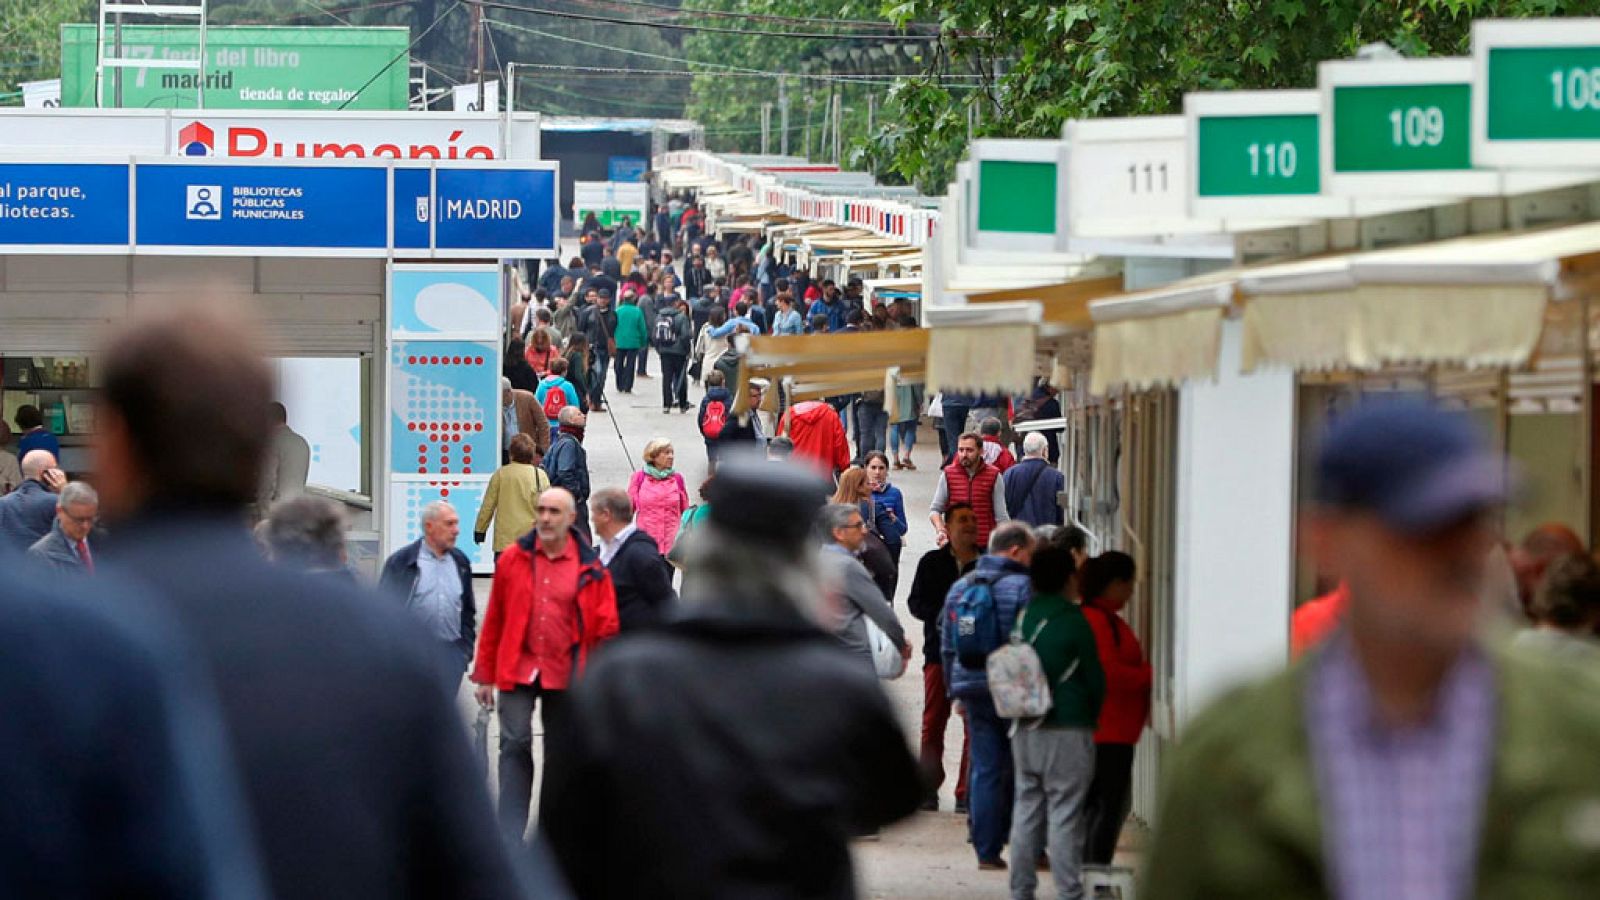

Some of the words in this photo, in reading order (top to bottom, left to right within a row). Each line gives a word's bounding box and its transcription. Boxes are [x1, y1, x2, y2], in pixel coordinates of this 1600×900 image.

[216, 47, 247, 66] del
[253, 47, 300, 68] libro
[239, 88, 282, 101] tienda
[287, 88, 304, 101] de
[1388, 106, 1444, 147] 109
[1247, 141, 1297, 178] 110
[1127, 163, 1169, 193] 111
[18, 185, 87, 201] parque,
[232, 186, 303, 198] BIBLIOTECAS
[232, 196, 286, 208] PÚBLICAS
[446, 199, 522, 220] MADRID
[232, 209, 304, 220] MUNICIPALES
